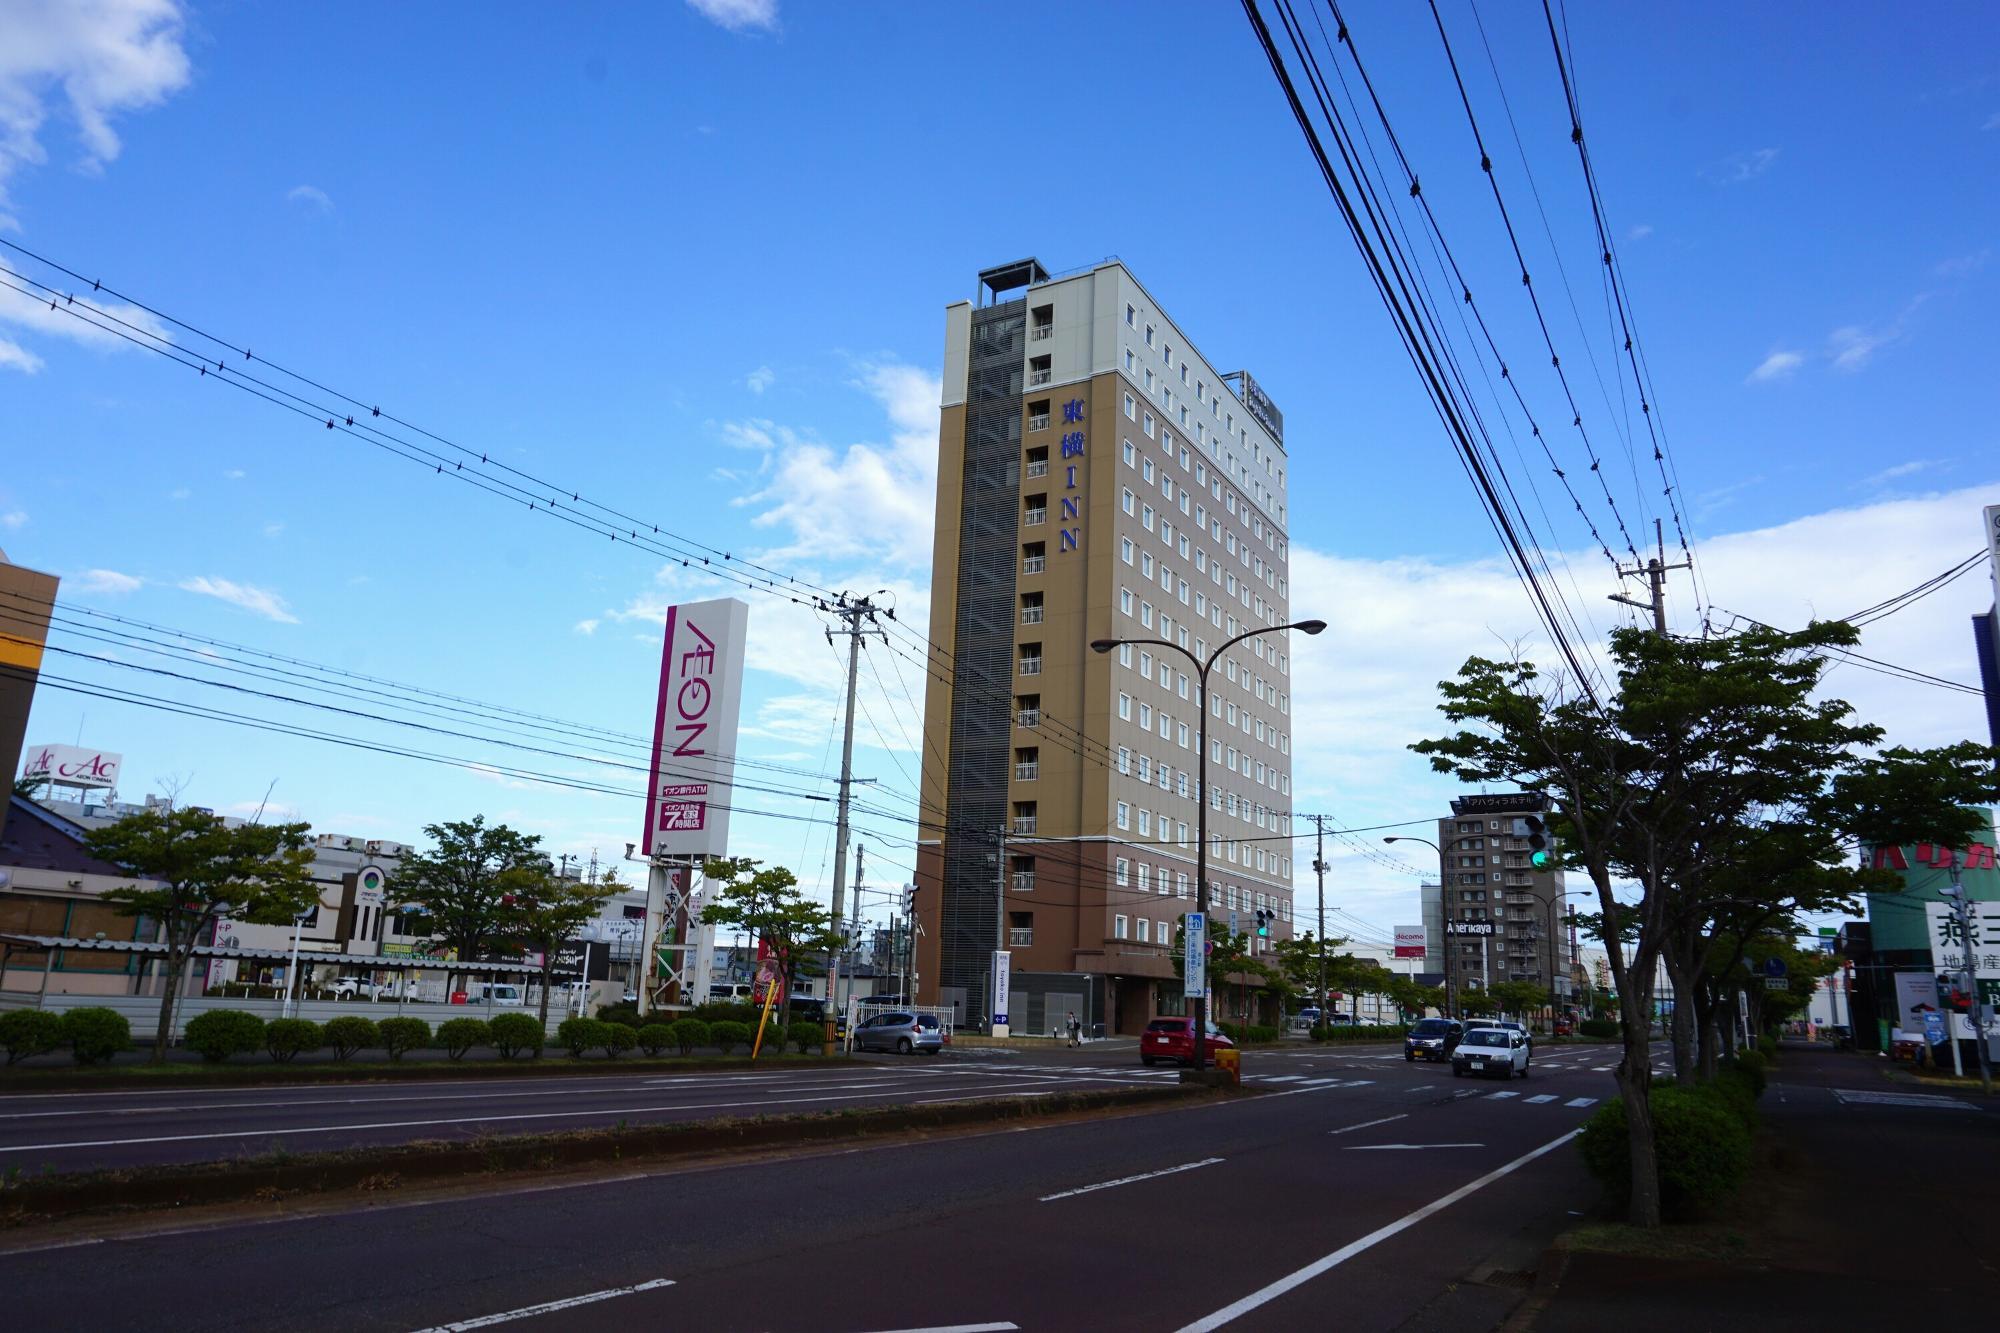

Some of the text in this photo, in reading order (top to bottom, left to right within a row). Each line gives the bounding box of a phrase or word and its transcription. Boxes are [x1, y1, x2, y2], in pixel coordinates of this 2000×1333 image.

[673, 619, 715, 757] AEON
[664, 811, 682, 829] 7
[1395, 932, 1424, 940] docomo
